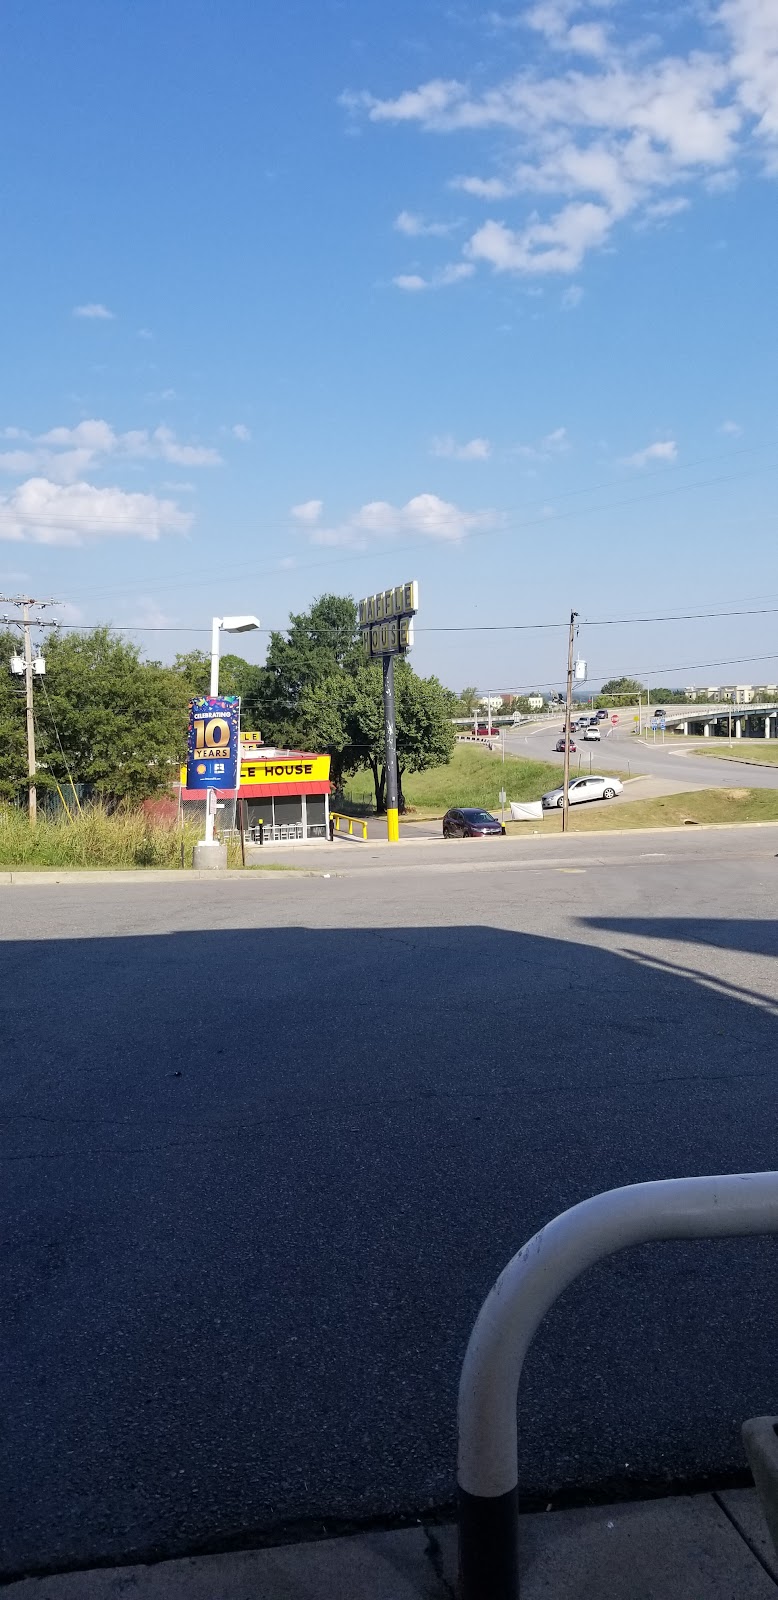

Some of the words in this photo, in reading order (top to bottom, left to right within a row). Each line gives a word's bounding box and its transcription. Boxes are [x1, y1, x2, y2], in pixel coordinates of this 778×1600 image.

[360, 586, 411, 621] WAFFLE
[363, 621, 407, 650] HOUSE
[194, 711, 231, 719] CELEBRATING
[193, 718, 230, 748] 10
[196, 749, 228, 758] YEARS
[265, 764, 313, 776] HOUSE
